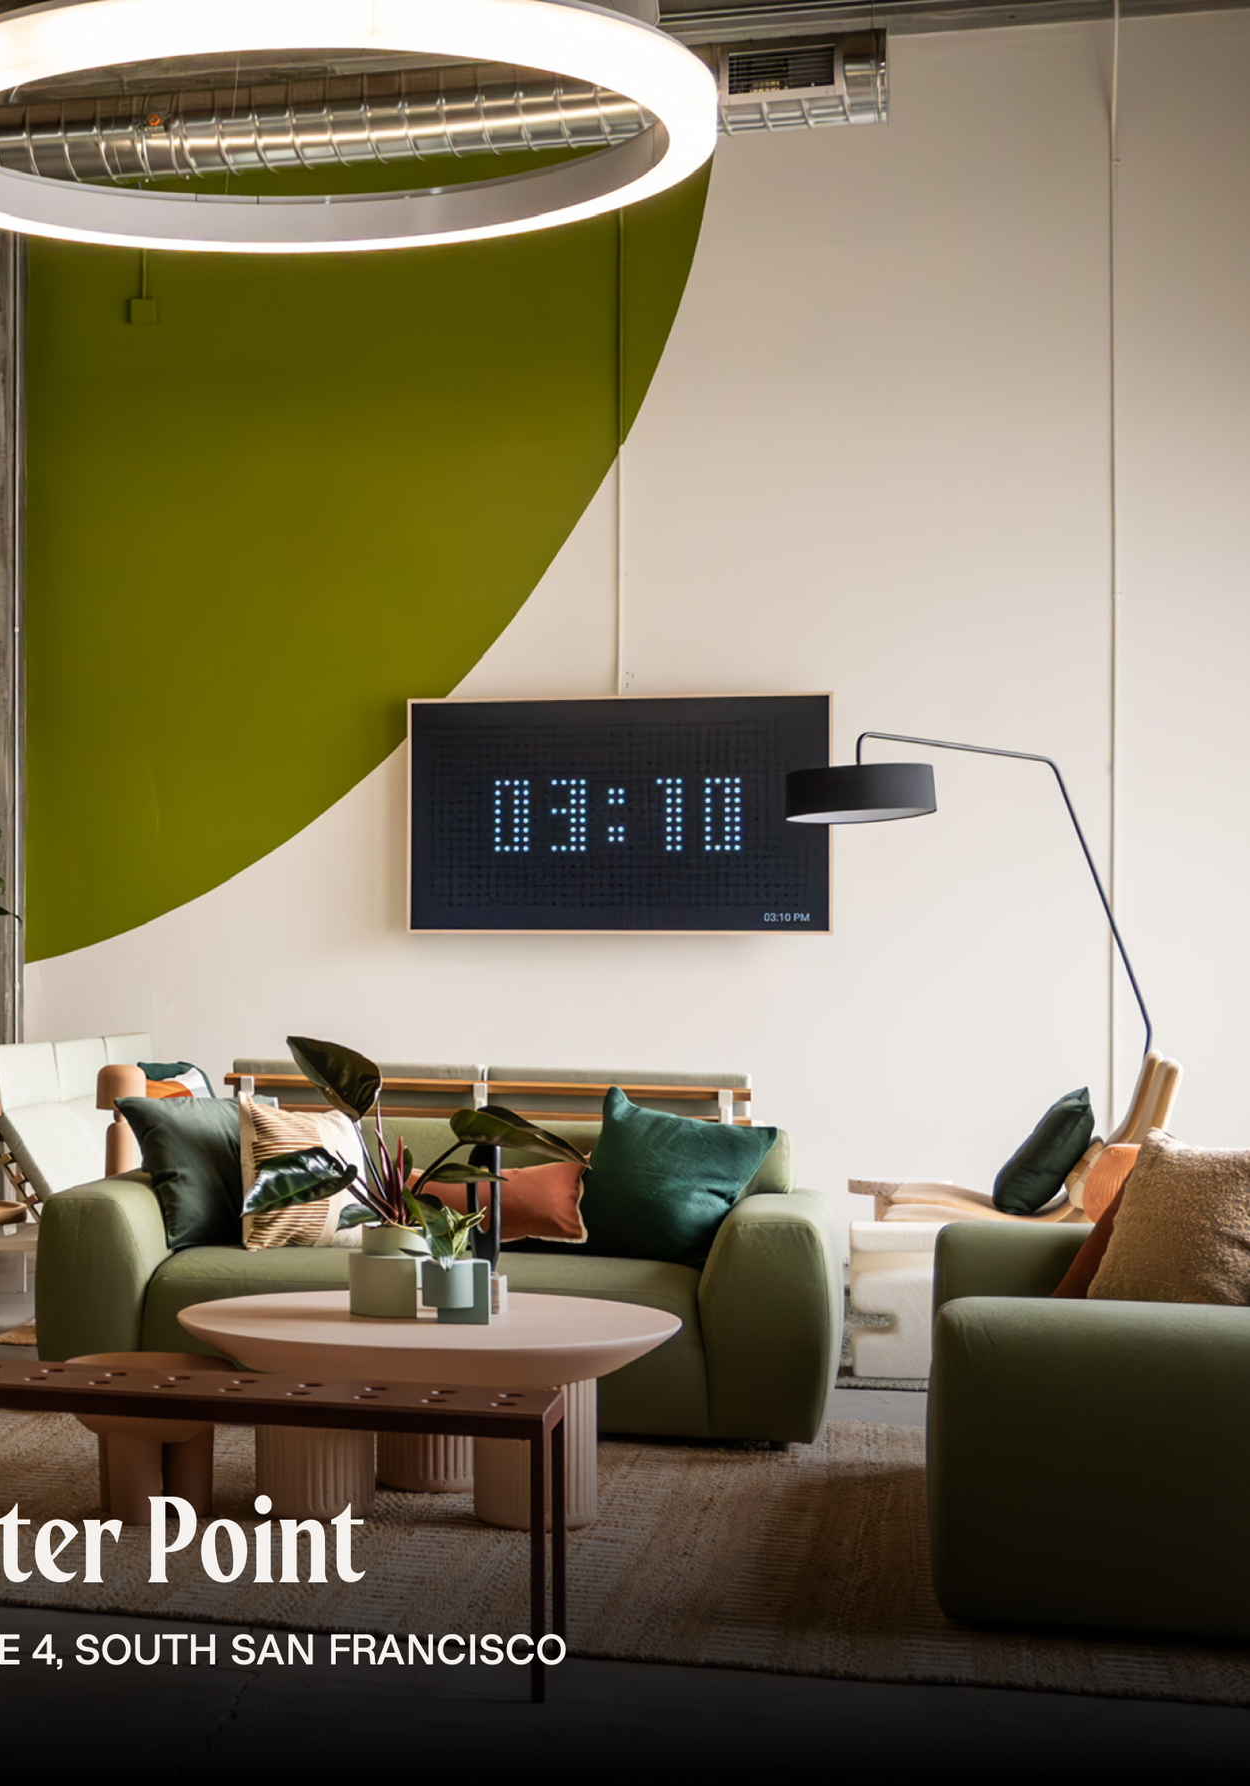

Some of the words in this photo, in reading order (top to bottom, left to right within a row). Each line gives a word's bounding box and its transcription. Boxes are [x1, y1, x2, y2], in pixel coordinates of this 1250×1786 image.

[494, 777, 741, 853] 03:10
[763, 912, 791, 922] 03:10
[793, 912, 810, 922] PM
